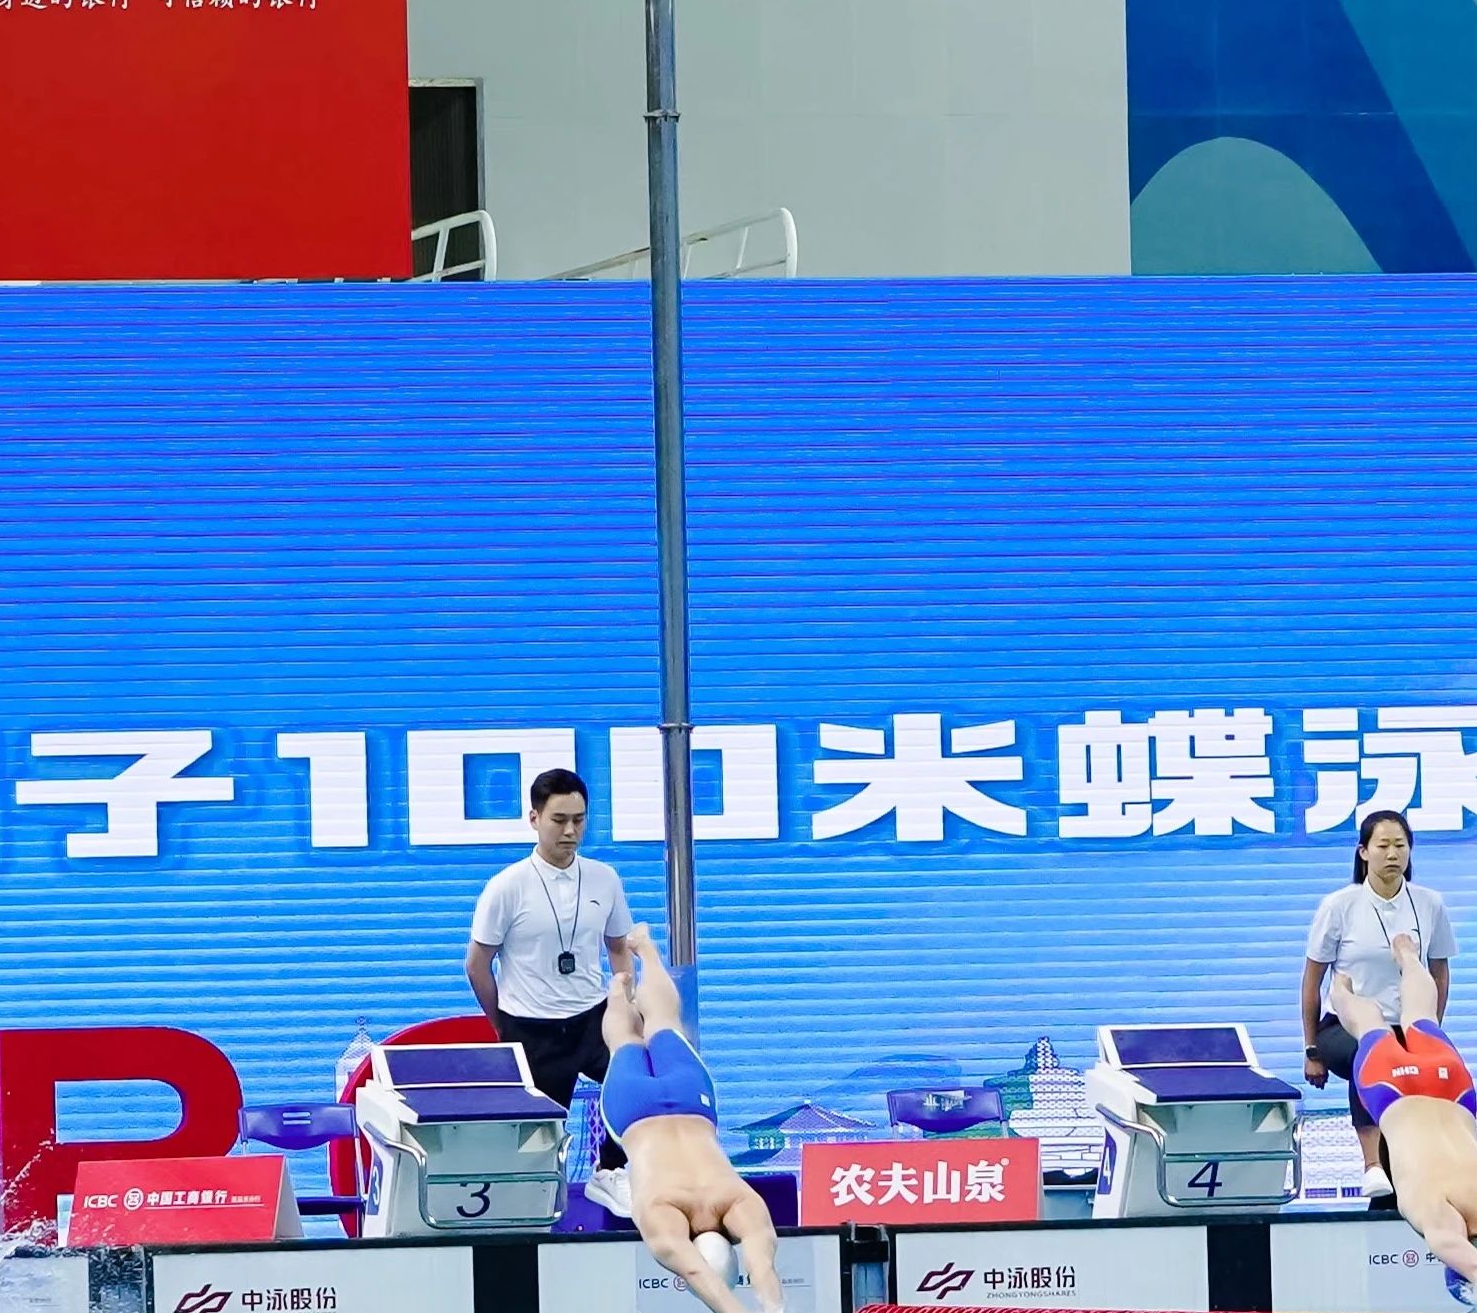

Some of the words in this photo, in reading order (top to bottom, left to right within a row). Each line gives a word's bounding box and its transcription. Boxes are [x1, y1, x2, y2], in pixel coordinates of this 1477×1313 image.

[1103, 1146, 1113, 1185] 4
[372, 1165, 381, 1207] 3
[829, 1159, 1007, 1208] 农夫山泉
[1187, 1161, 1224, 1197] 4
[83, 1194, 119, 1209] ICBC
[146, 1189, 229, 1206] 中国工商银行
[455, 1182, 492, 1218] 3
[1368, 1253, 1399, 1266] ICBC
[638, 1277, 670, 1290] ICBC
[983, 1265, 1076, 1290] 中泳股份
[241, 1286, 338, 1312] 中泳股份
